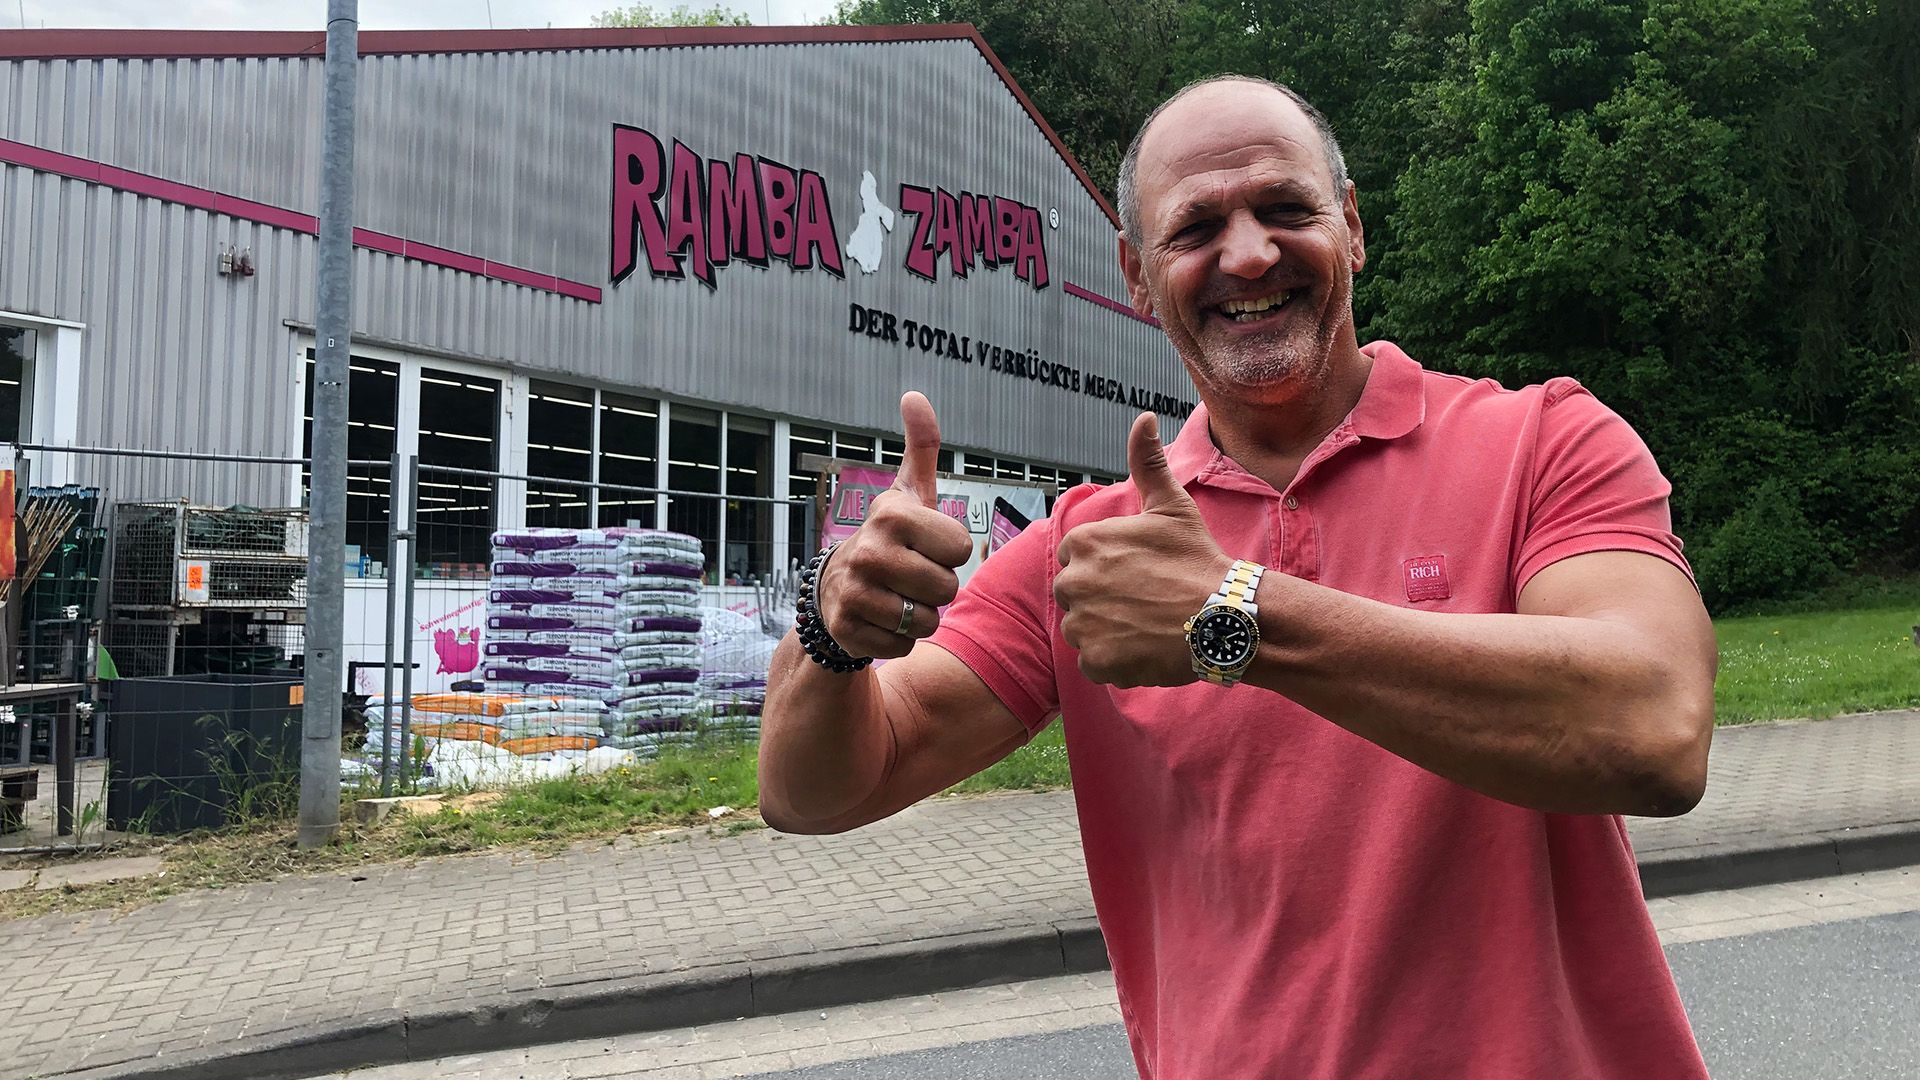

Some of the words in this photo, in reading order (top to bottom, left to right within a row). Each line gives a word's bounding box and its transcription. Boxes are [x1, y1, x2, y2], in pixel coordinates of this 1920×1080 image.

[610, 122, 845, 290] RAMBA
[899, 182, 1051, 290] ZAMBA
[848, 302, 900, 342] DER
[902, 319, 973, 364] TOTAL
[976, 340, 1081, 393] VERRÜCKTE
[1083, 372, 1127, 405] MEGA
[1410, 565, 1440, 579] RICH
